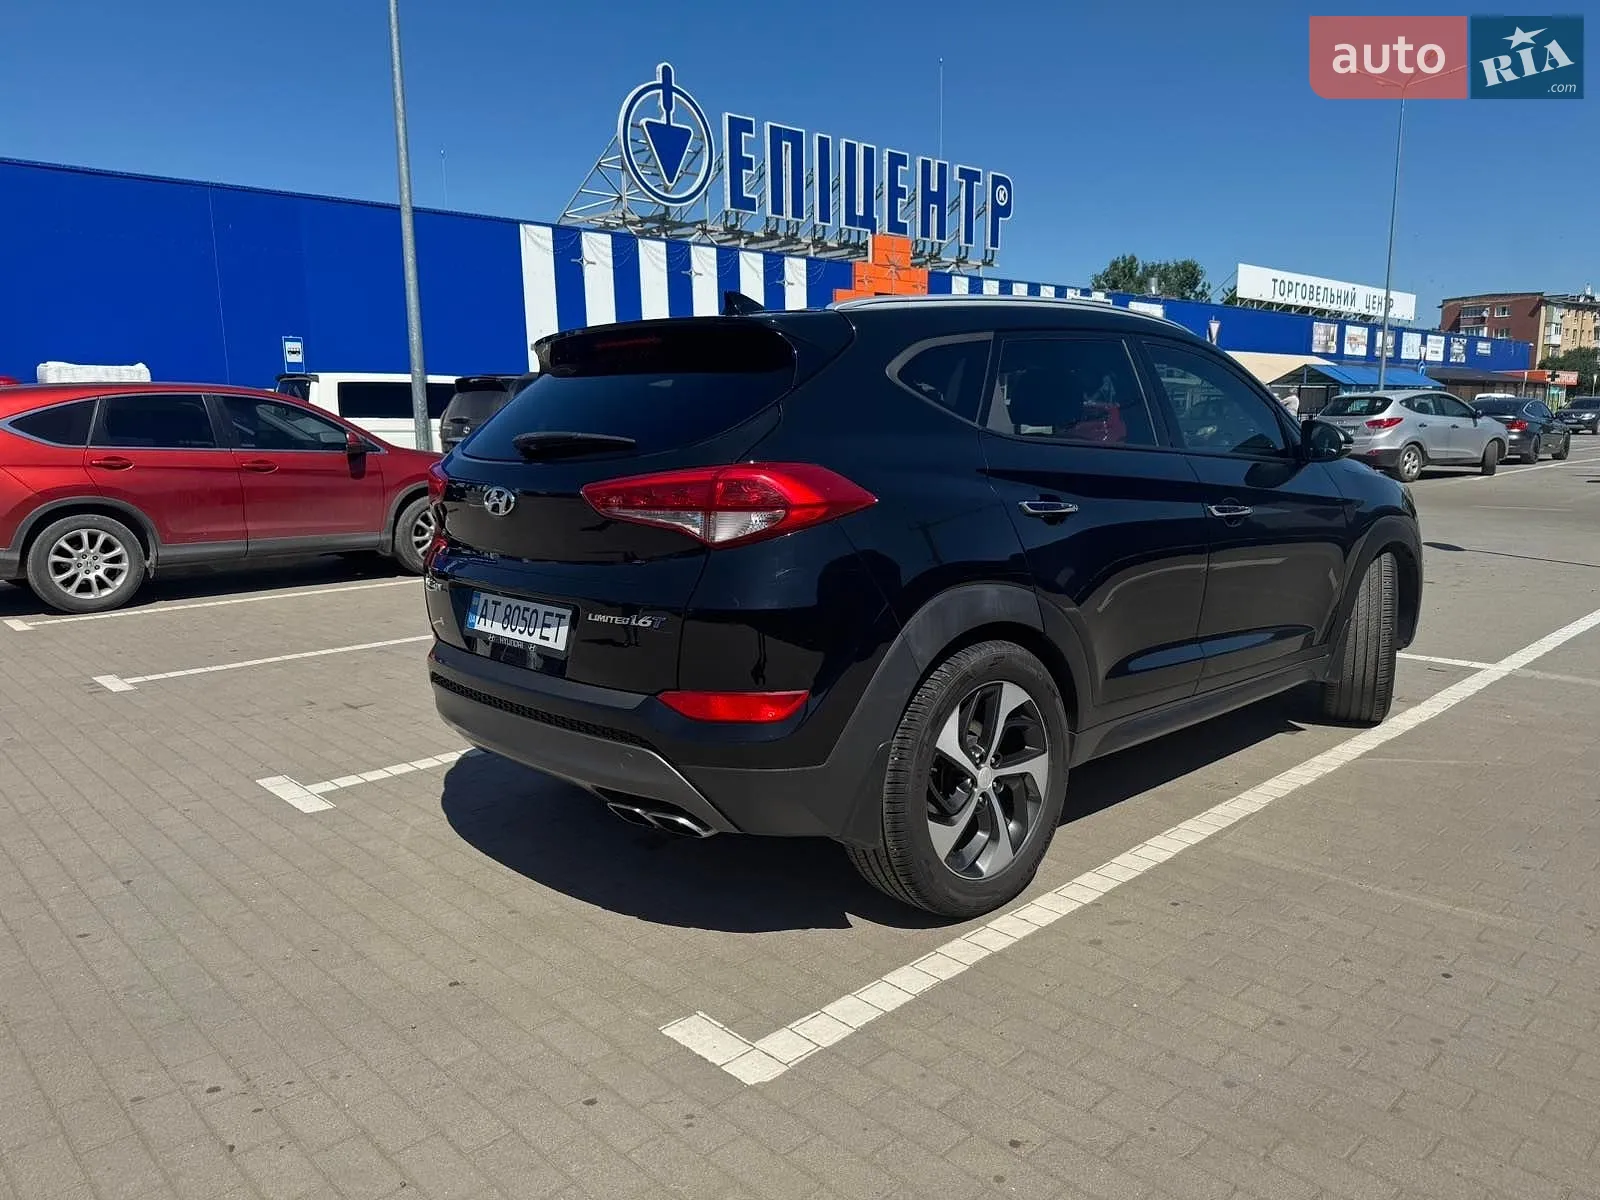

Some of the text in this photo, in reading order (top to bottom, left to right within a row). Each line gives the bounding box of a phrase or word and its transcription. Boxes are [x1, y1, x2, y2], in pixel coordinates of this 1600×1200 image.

[722, 111, 1013, 250] ЕПІЦЕНТР
[1271, 278, 1357, 308] ТОРГОВЕЛЬНИЙ
[501, 603, 539, 637] 8050
[587, 612, 630, 625] LIMITED
